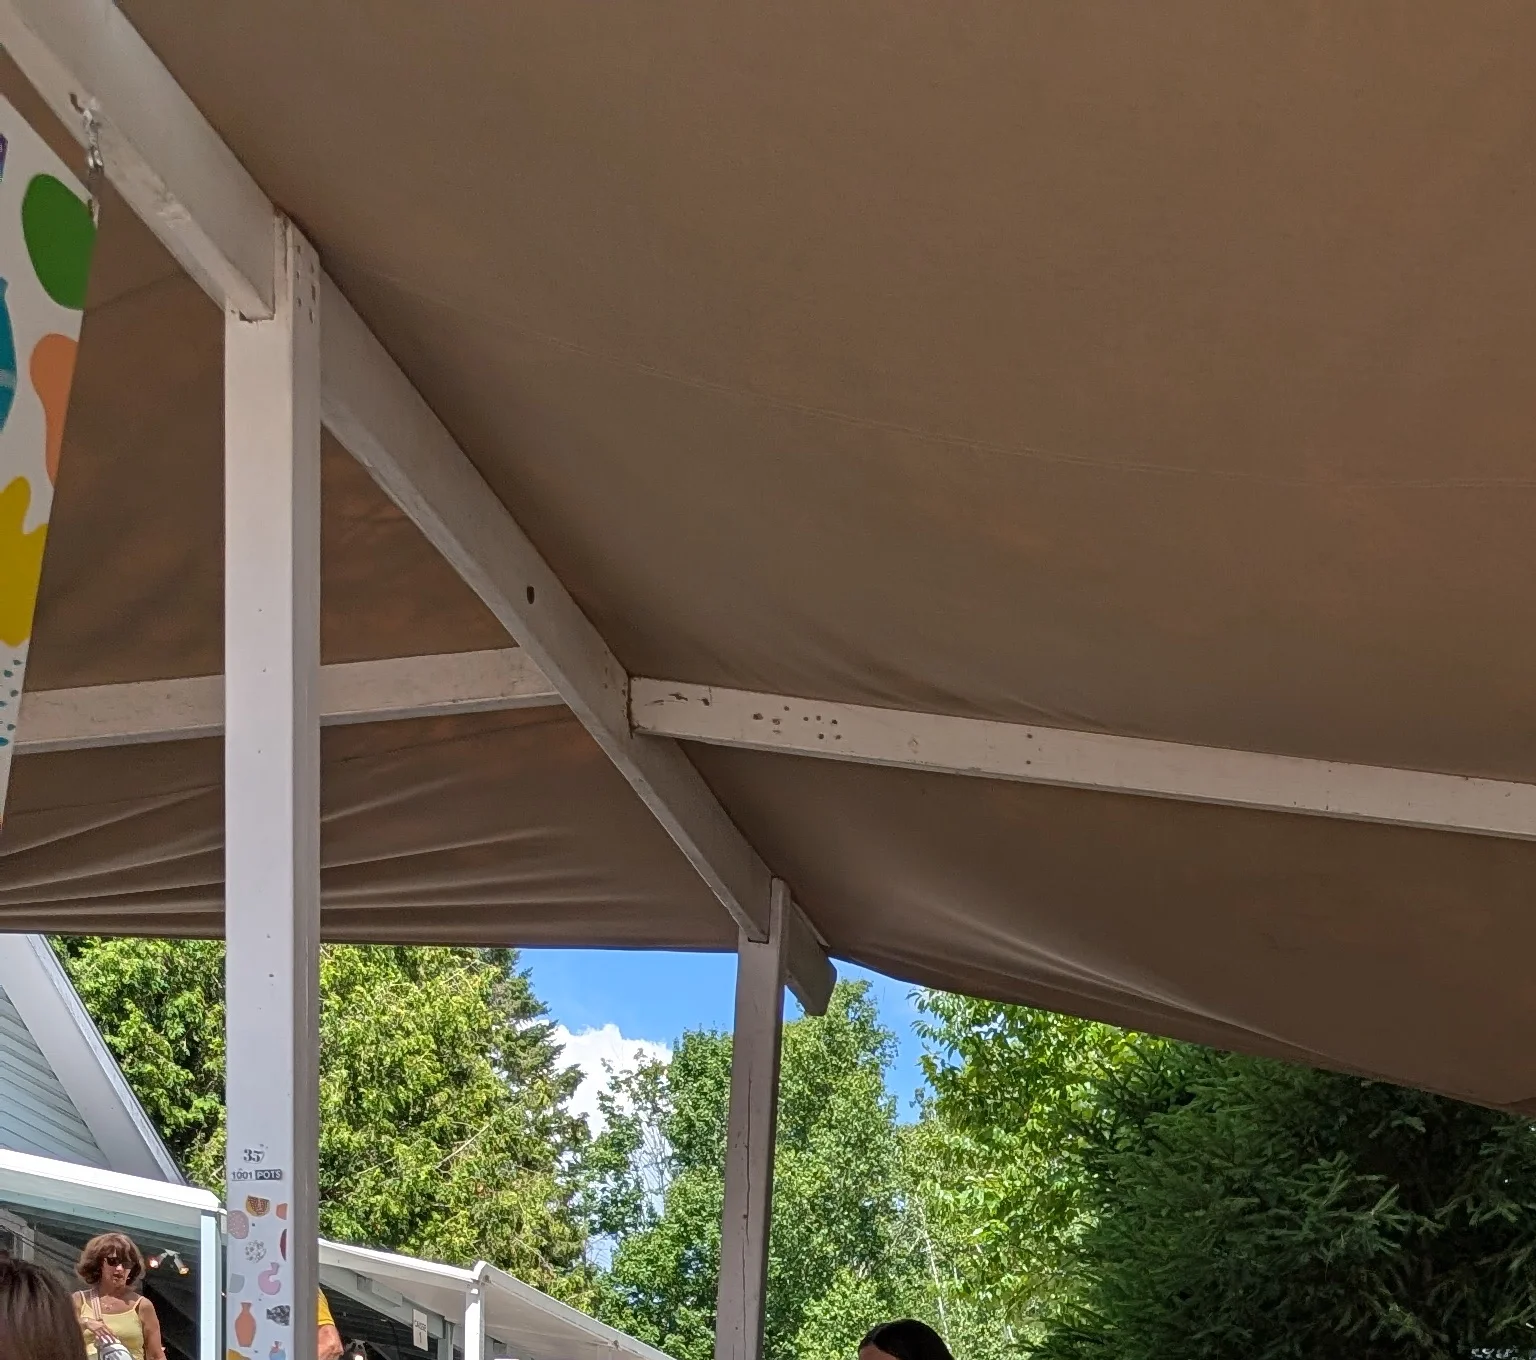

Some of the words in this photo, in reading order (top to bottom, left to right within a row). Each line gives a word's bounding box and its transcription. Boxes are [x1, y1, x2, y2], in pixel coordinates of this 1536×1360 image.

[243, 1148, 261, 1162] 35
[231, 1170, 253, 1180] 1001
[256, 1169, 281, 1180] POTS
